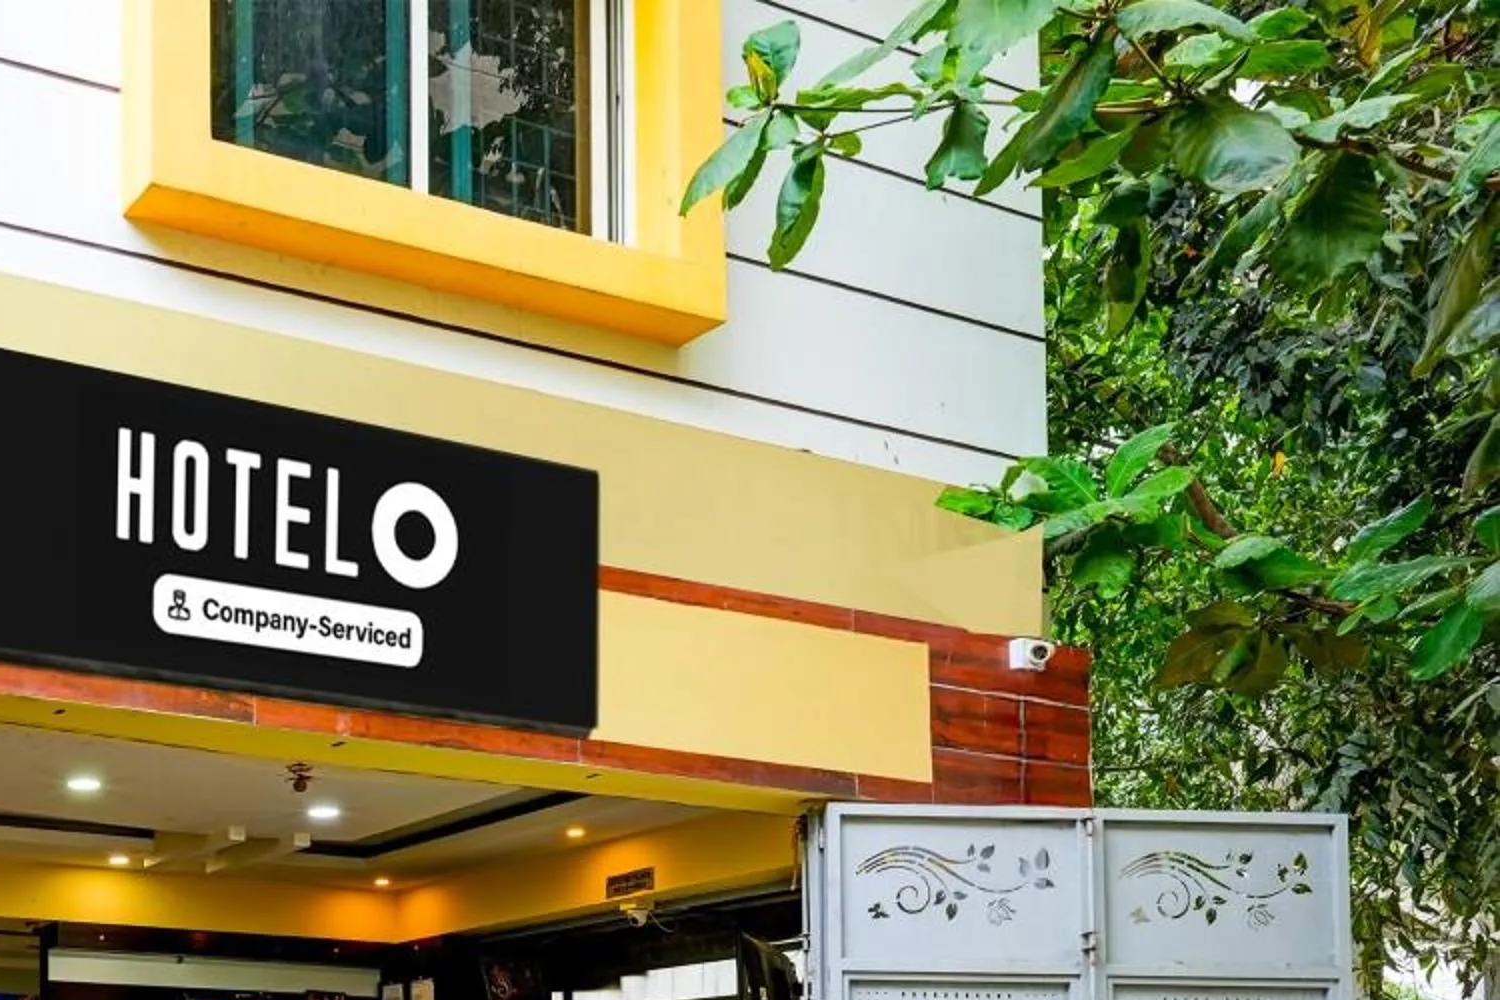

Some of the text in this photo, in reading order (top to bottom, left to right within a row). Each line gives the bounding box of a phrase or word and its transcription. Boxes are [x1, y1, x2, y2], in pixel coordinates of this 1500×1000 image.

[116, 427, 459, 589] HOTEL O
[202, 598, 412, 649] Company-Serviced
